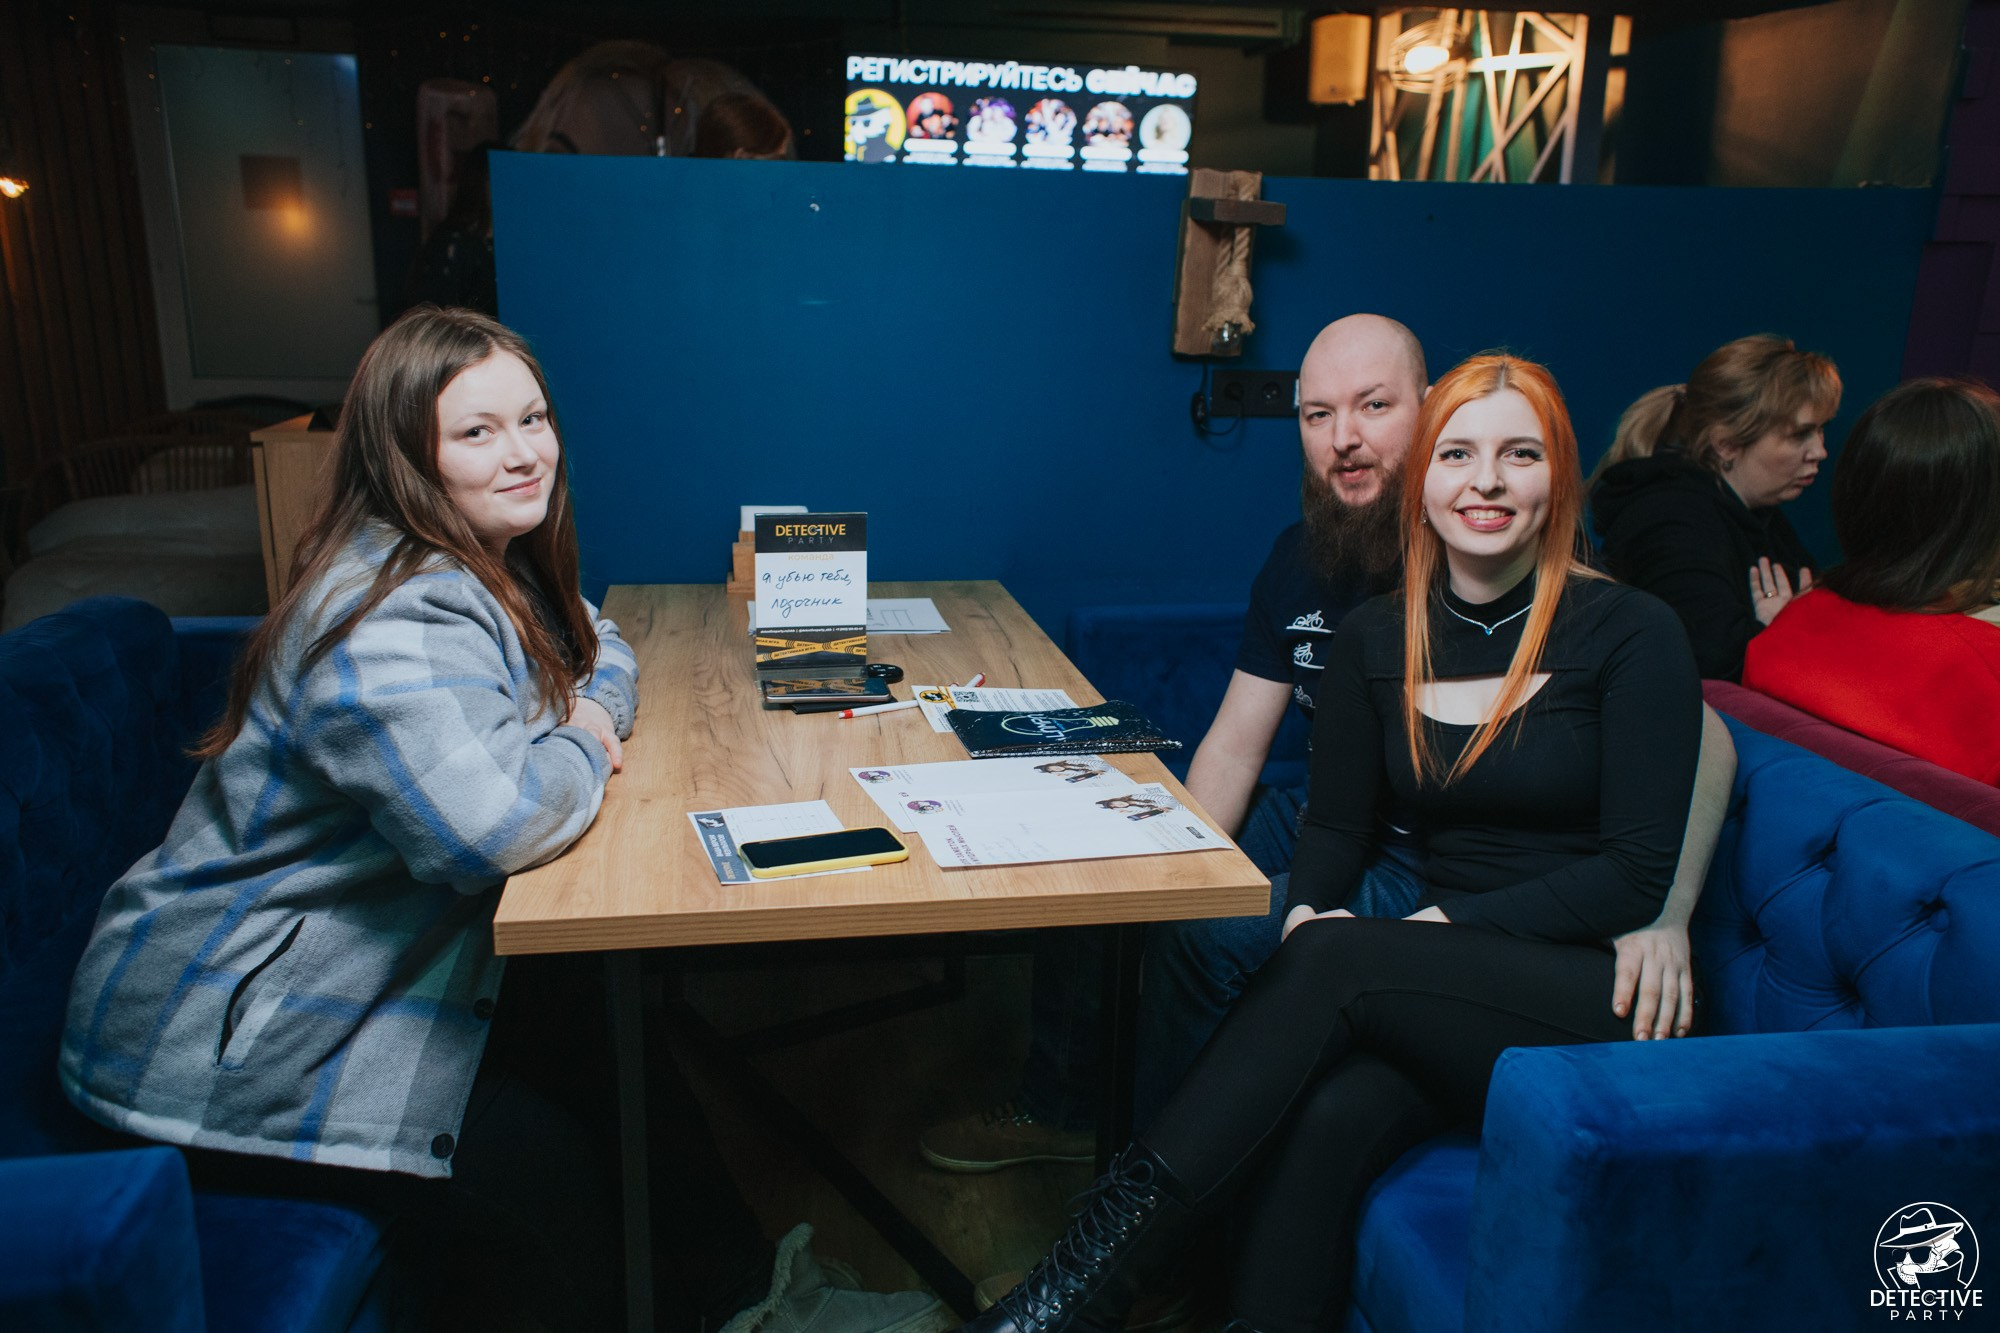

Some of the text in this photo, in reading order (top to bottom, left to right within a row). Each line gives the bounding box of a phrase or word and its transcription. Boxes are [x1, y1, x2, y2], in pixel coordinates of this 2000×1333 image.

[846, 56, 1083, 93] РЕГИСТРИРУЙТЕСЬ
[775, 523, 846, 537] DETECTIVE
[788, 536, 834, 545] PARTY
